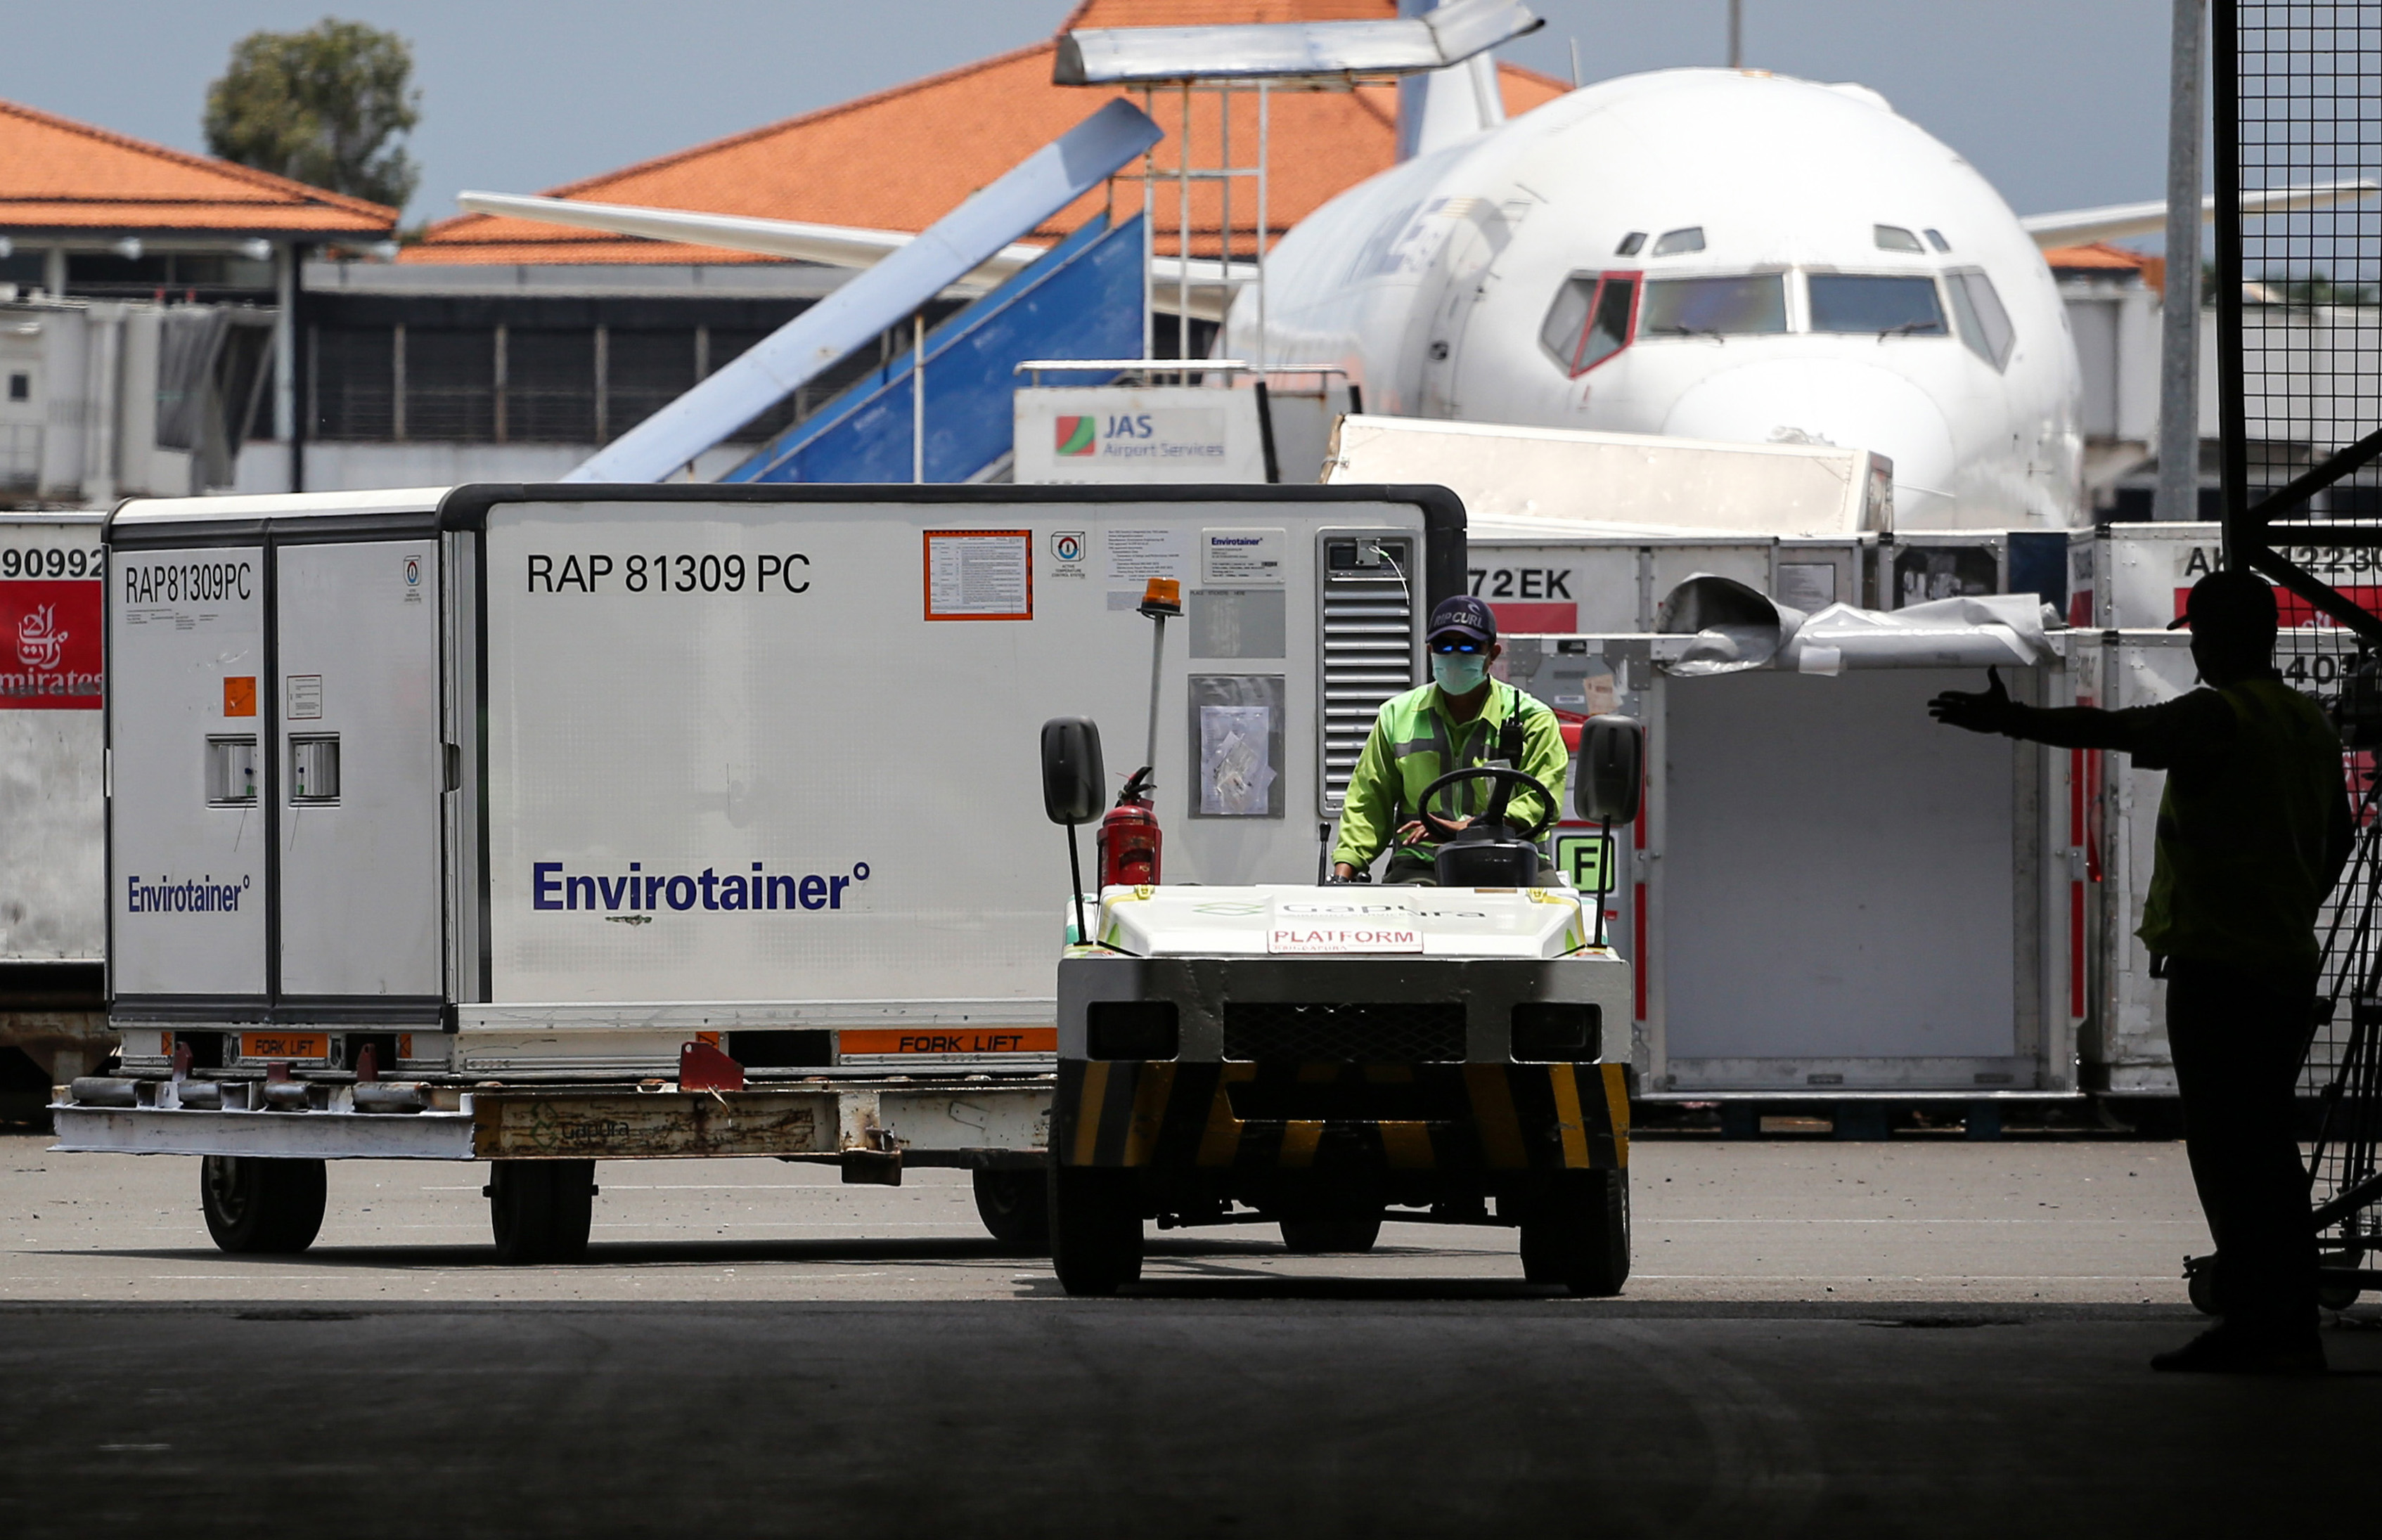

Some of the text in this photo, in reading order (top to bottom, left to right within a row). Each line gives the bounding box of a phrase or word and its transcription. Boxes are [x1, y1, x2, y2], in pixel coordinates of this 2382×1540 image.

[1104, 415, 1153, 439] JAS
[1104, 444, 1225, 457] Airport Services
[528, 554, 811, 593] RAP 81309 PC
[1434, 612, 1483, 628] RIP CURL
[1573, 847, 1598, 884] F
[1274, 931, 1414, 943] PLATFORM
[255, 1039, 314, 1055] FORK LIFT
[899, 1035, 1024, 1052] FORK LIFT
